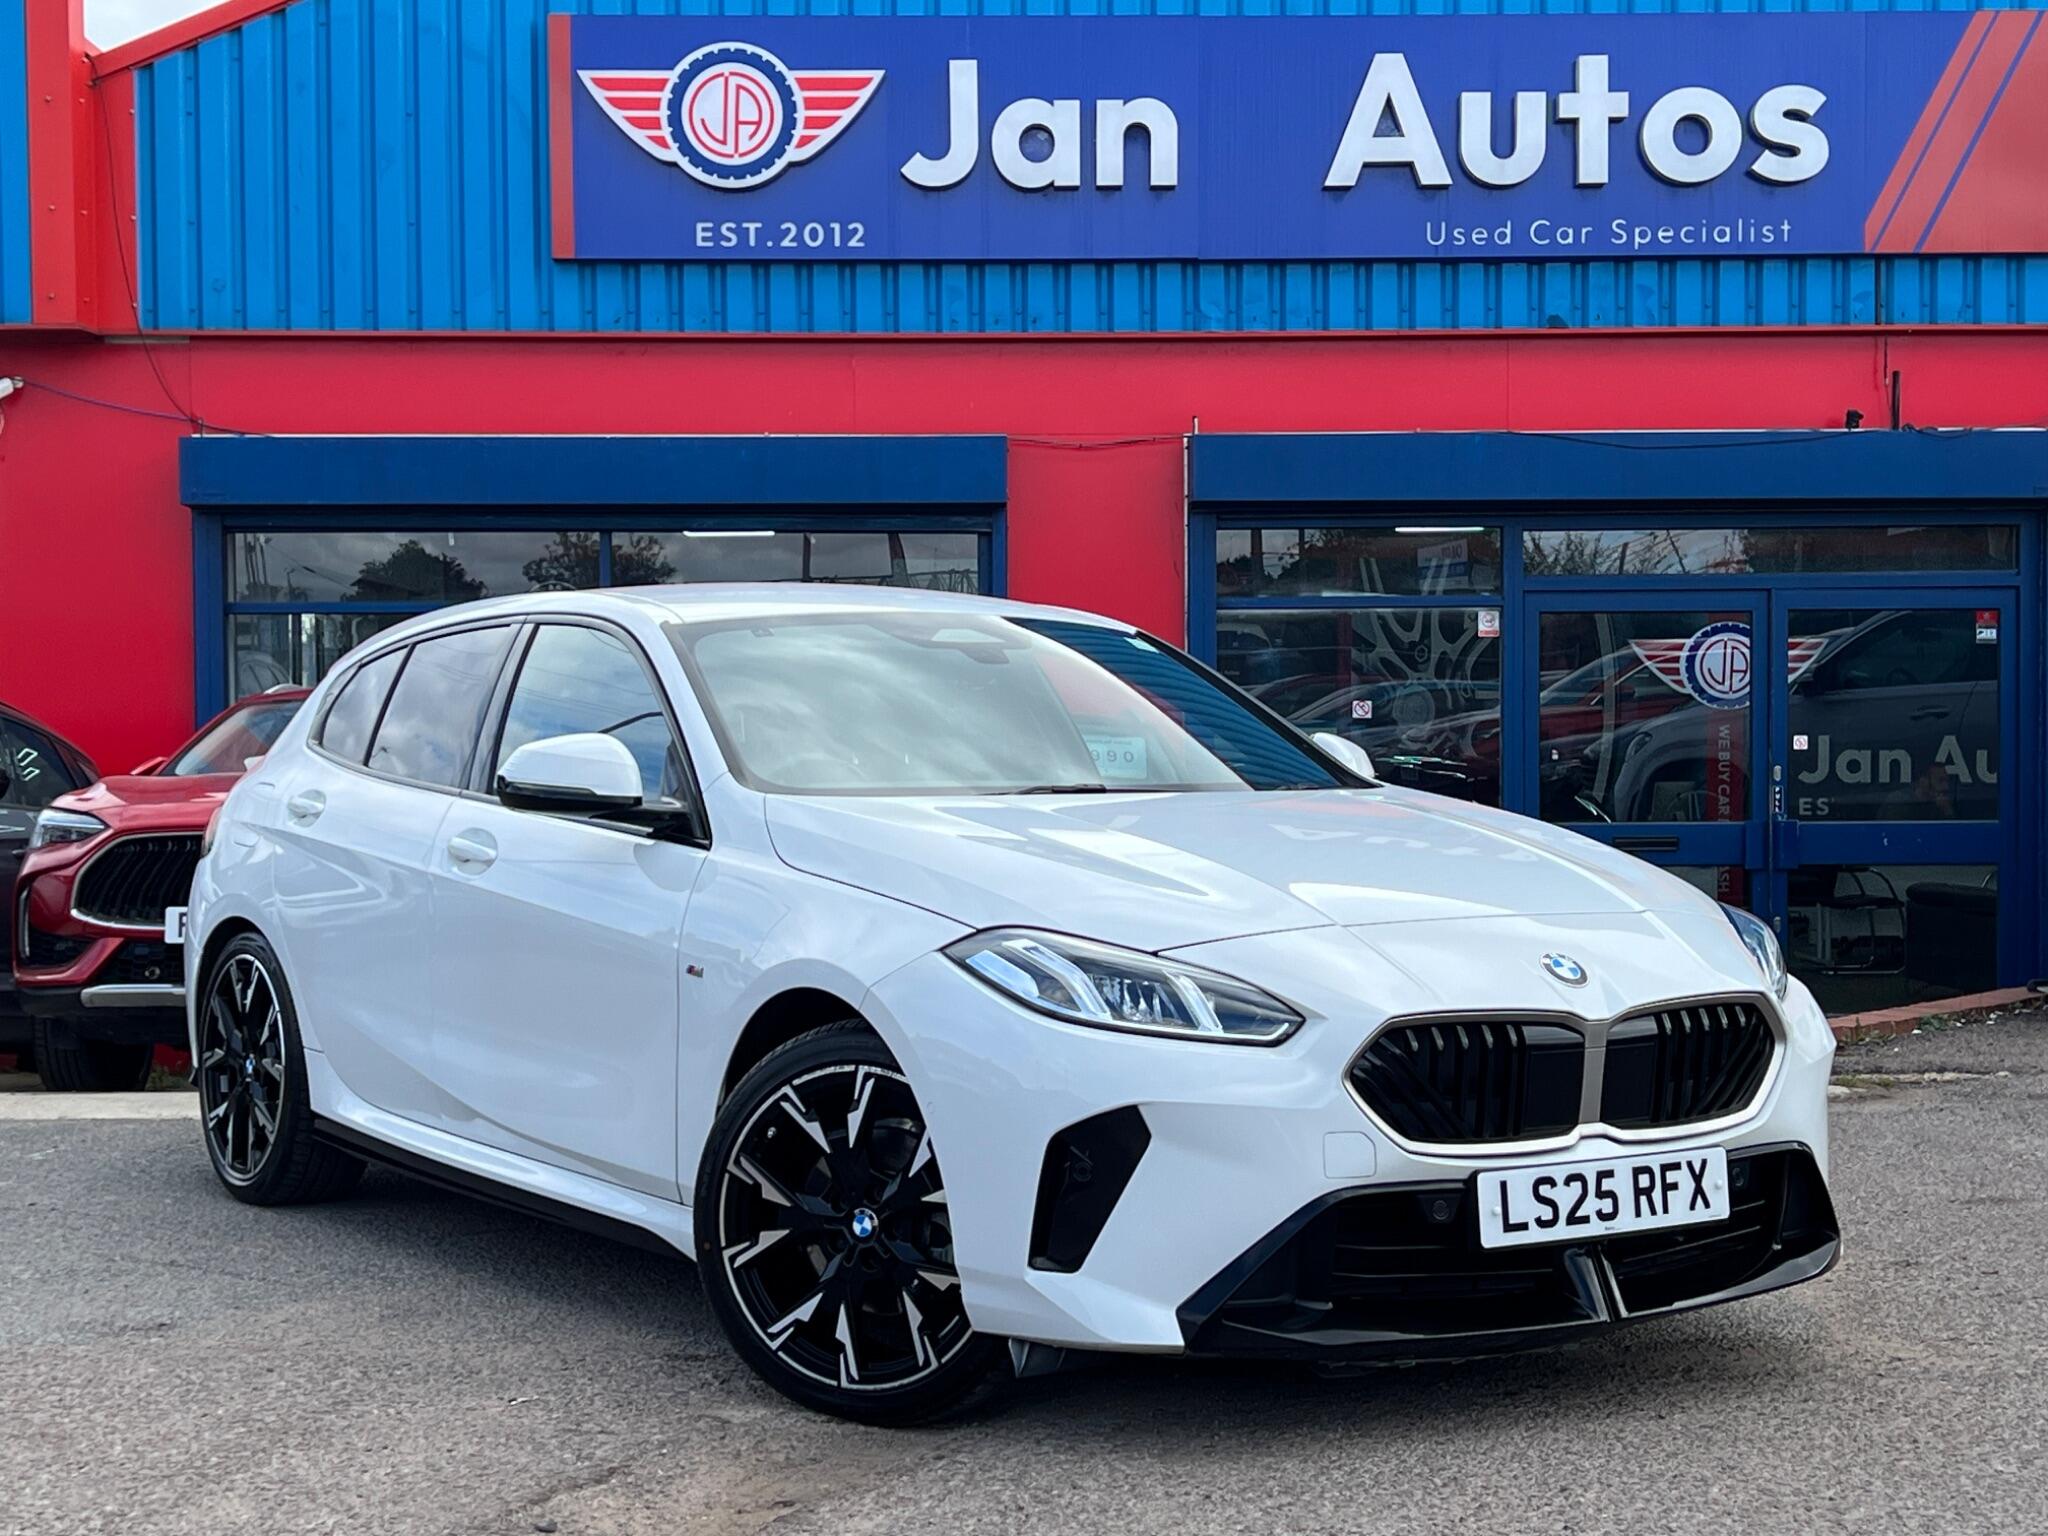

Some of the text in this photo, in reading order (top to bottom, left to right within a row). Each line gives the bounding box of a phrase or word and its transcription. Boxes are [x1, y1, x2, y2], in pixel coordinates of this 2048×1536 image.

[901, 52, 1830, 190] Jan Autos
[695, 221, 866, 249] EST.2012
[1425, 217, 1793, 250] Used Car Specialist
[1718, 752, 1730, 782] BUY
[1798, 735, 1911, 784] Jan
[1718, 784, 1730, 815] CAR
[1500, 1158, 1711, 1233] LS25 RFX
